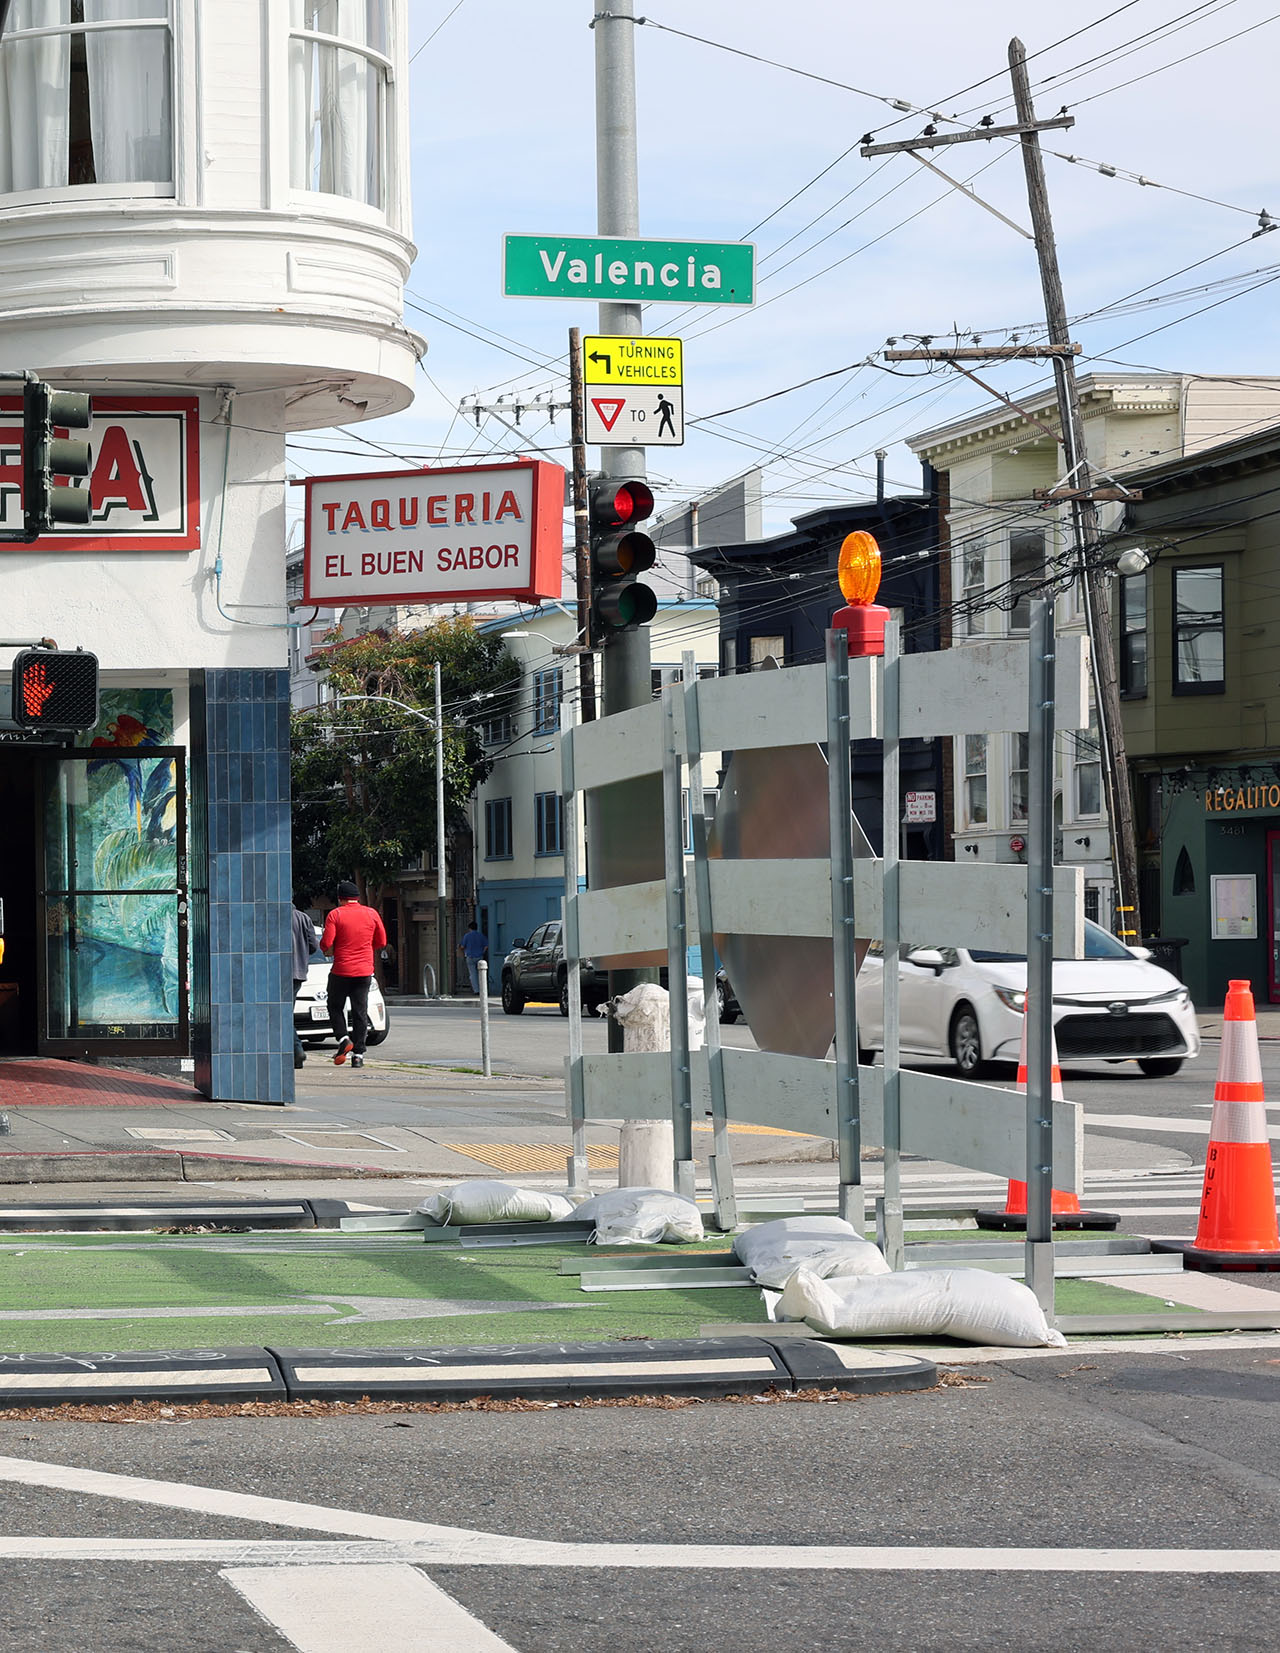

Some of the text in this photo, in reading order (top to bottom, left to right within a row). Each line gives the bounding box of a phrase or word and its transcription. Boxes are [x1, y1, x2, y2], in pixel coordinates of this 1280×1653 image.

[539, 250, 721, 288] Valencia
[618, 345, 674, 359] TURNING
[617, 365, 677, 378] VEHICLES
[630, 409, 646, 422] TO
[322, 491, 524, 534] TAQUERIA
[325, 544, 520, 577] EL BUEN SABOR
[1205, 785, 1280, 811] REGALITO
